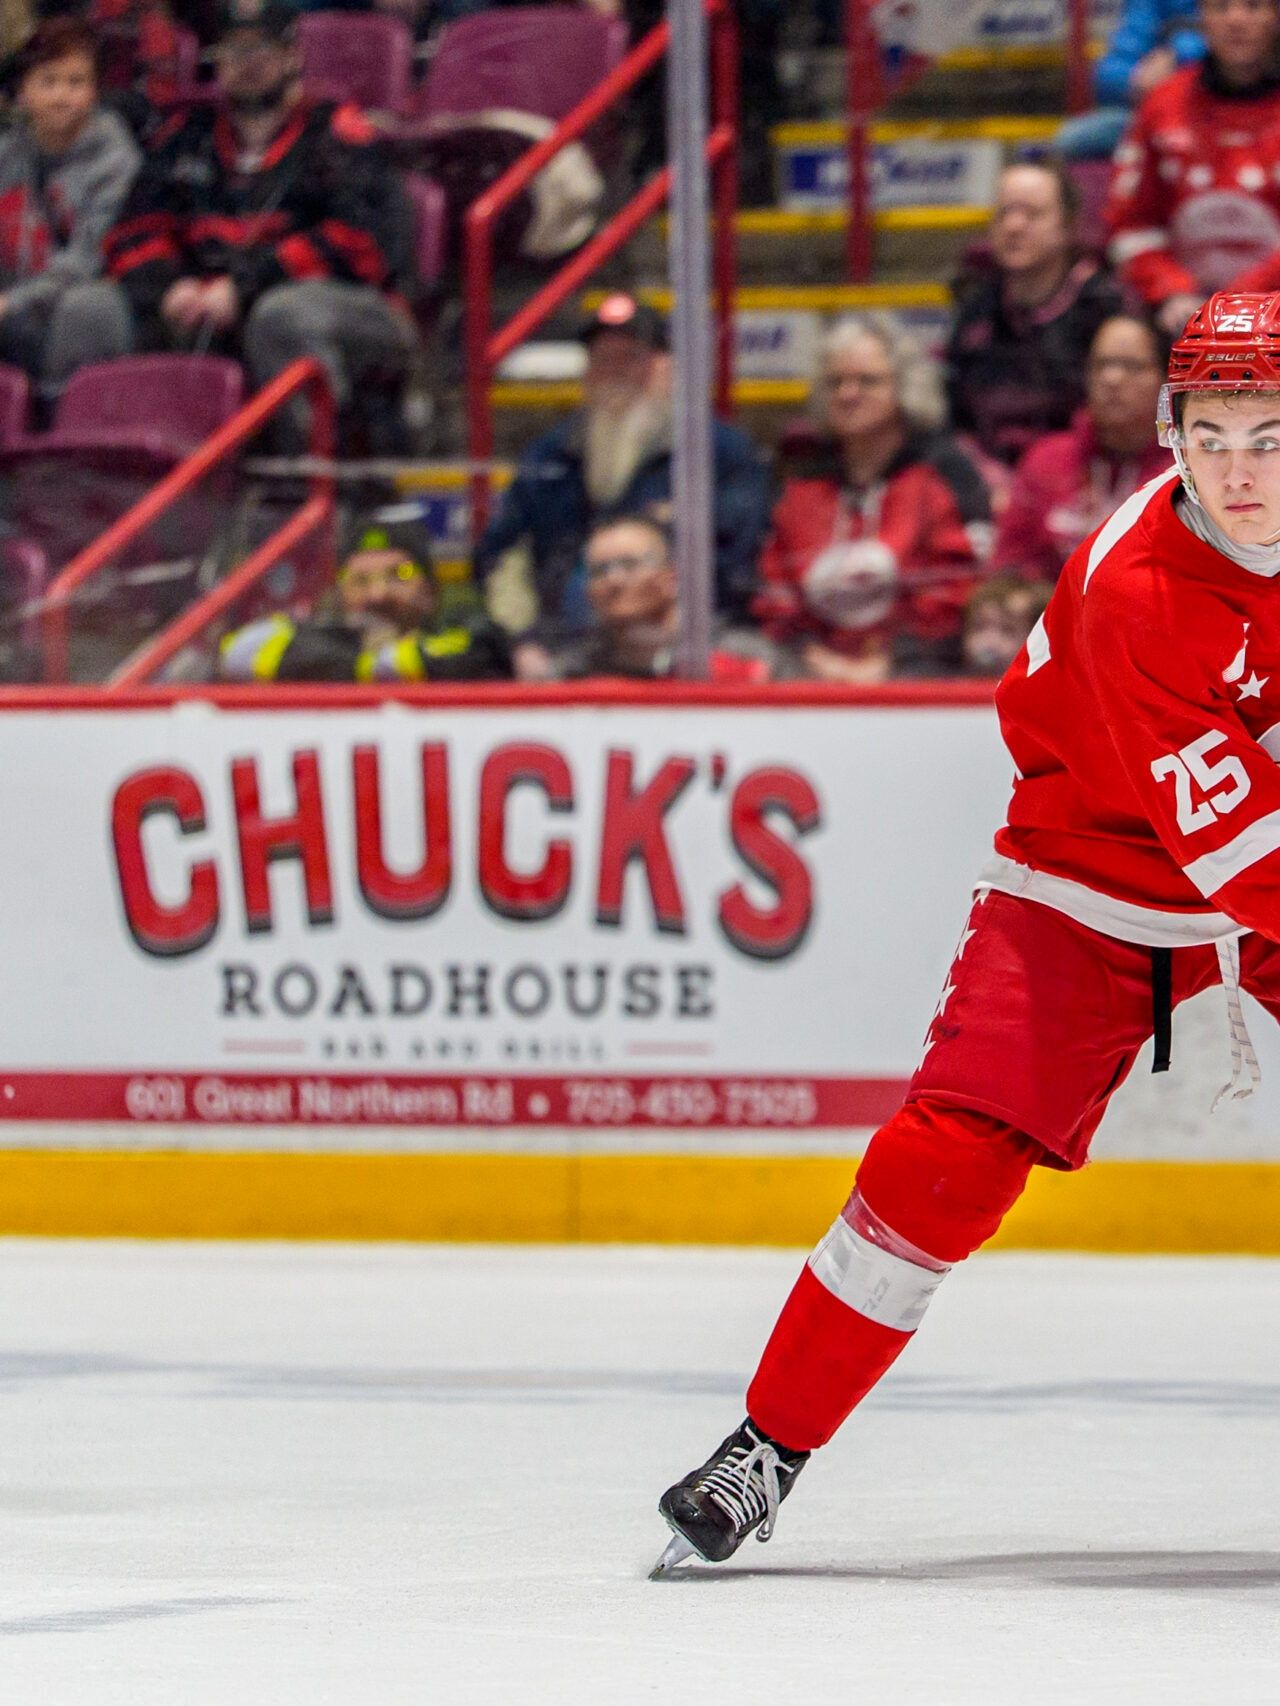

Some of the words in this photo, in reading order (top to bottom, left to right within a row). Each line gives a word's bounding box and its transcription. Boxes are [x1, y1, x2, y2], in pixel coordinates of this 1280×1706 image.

[1216, 314, 1255, 333] 25
[1150, 728, 1252, 837] 25
[111, 741, 822, 960] CHUCK'S
[220, 963, 715, 1020] ROADHOUSE
[410, 1039, 480, 1059] AND
[127, 1080, 184, 1119] 601
[196, 1080, 291, 1120] Great
[301, 1080, 457, 1120] Northern
[464, 1080, 512, 1121] Rd
